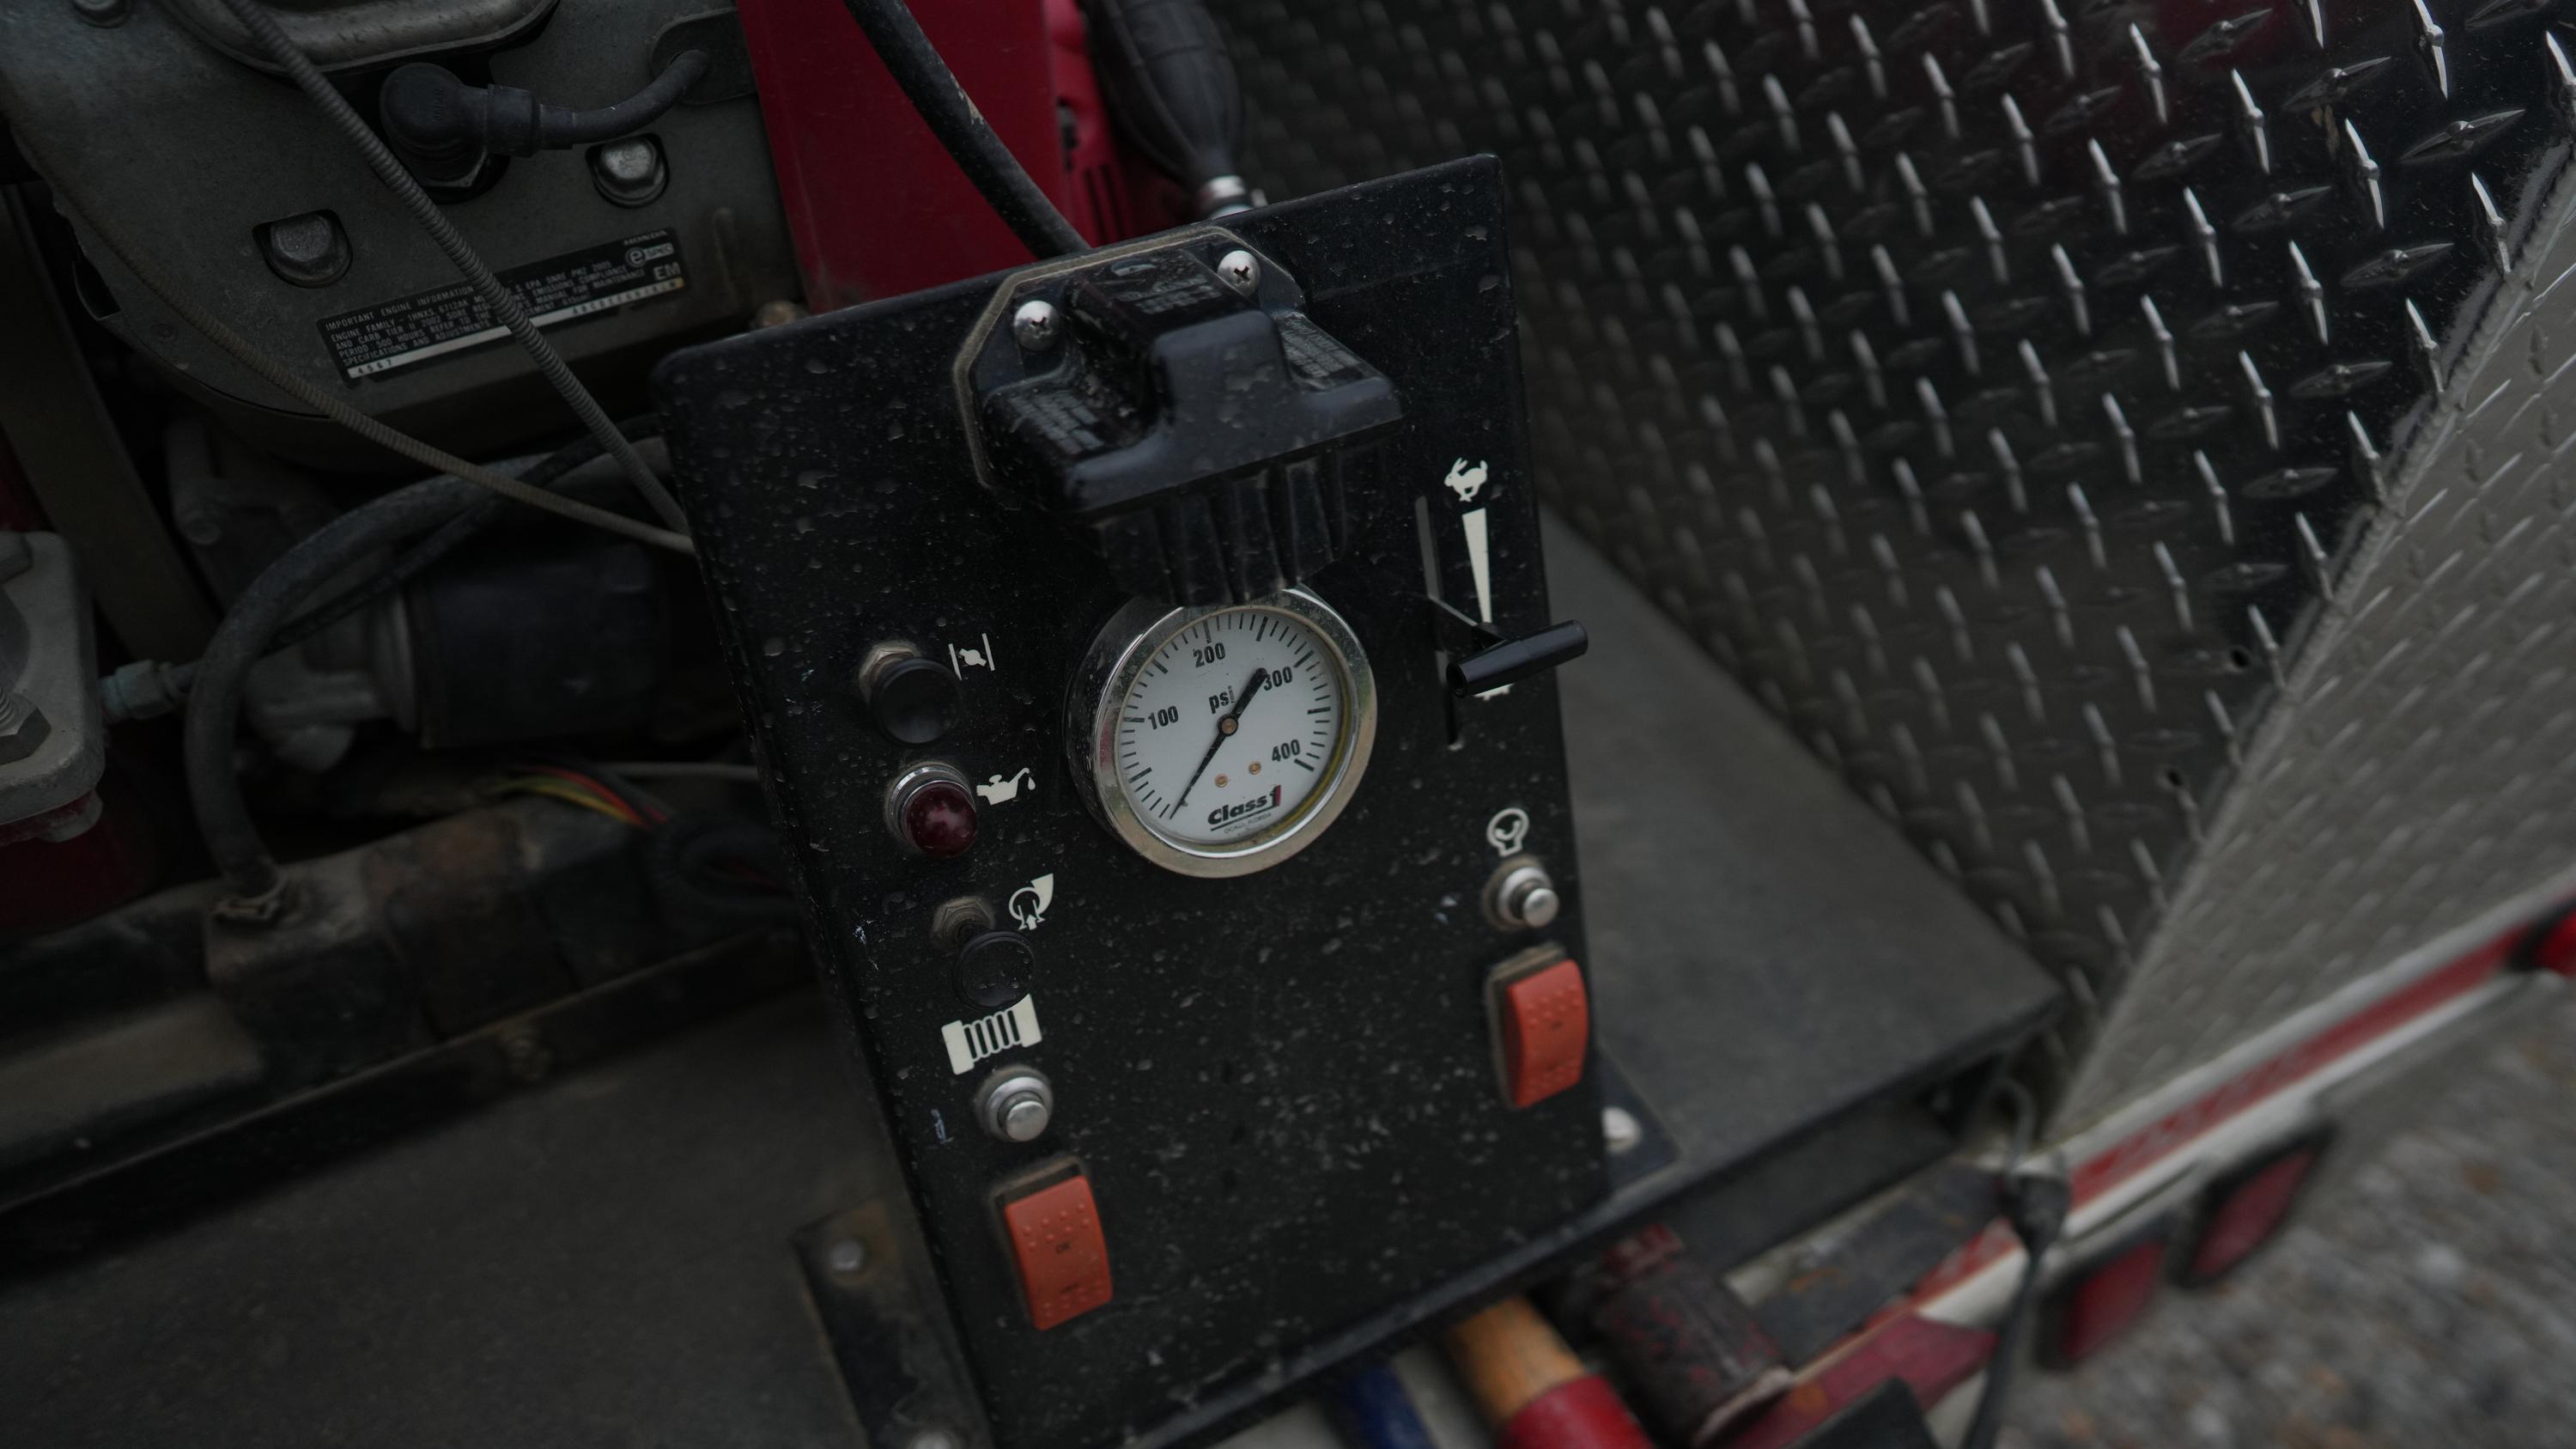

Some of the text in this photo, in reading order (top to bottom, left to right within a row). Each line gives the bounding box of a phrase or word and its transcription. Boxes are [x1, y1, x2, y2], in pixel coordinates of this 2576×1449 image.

[653, 261, 681, 280] EM
[326, 313, 374, 331] IMPORTANT
[381, 303, 410, 316] ENGINE
[418, 286, 474, 306] INFORMATION
[331, 329, 361, 342] ENGINE
[367, 320, 395, 332] FAMILY
[336, 340, 352, 350] AND
[1193, 642, 1226, 668] 200
[1263, 667, 1292, 691] 300
[1209, 685, 1235, 715] psi
[1148, 705, 1179, 730] 100
[1271, 740, 1300, 764] 400
